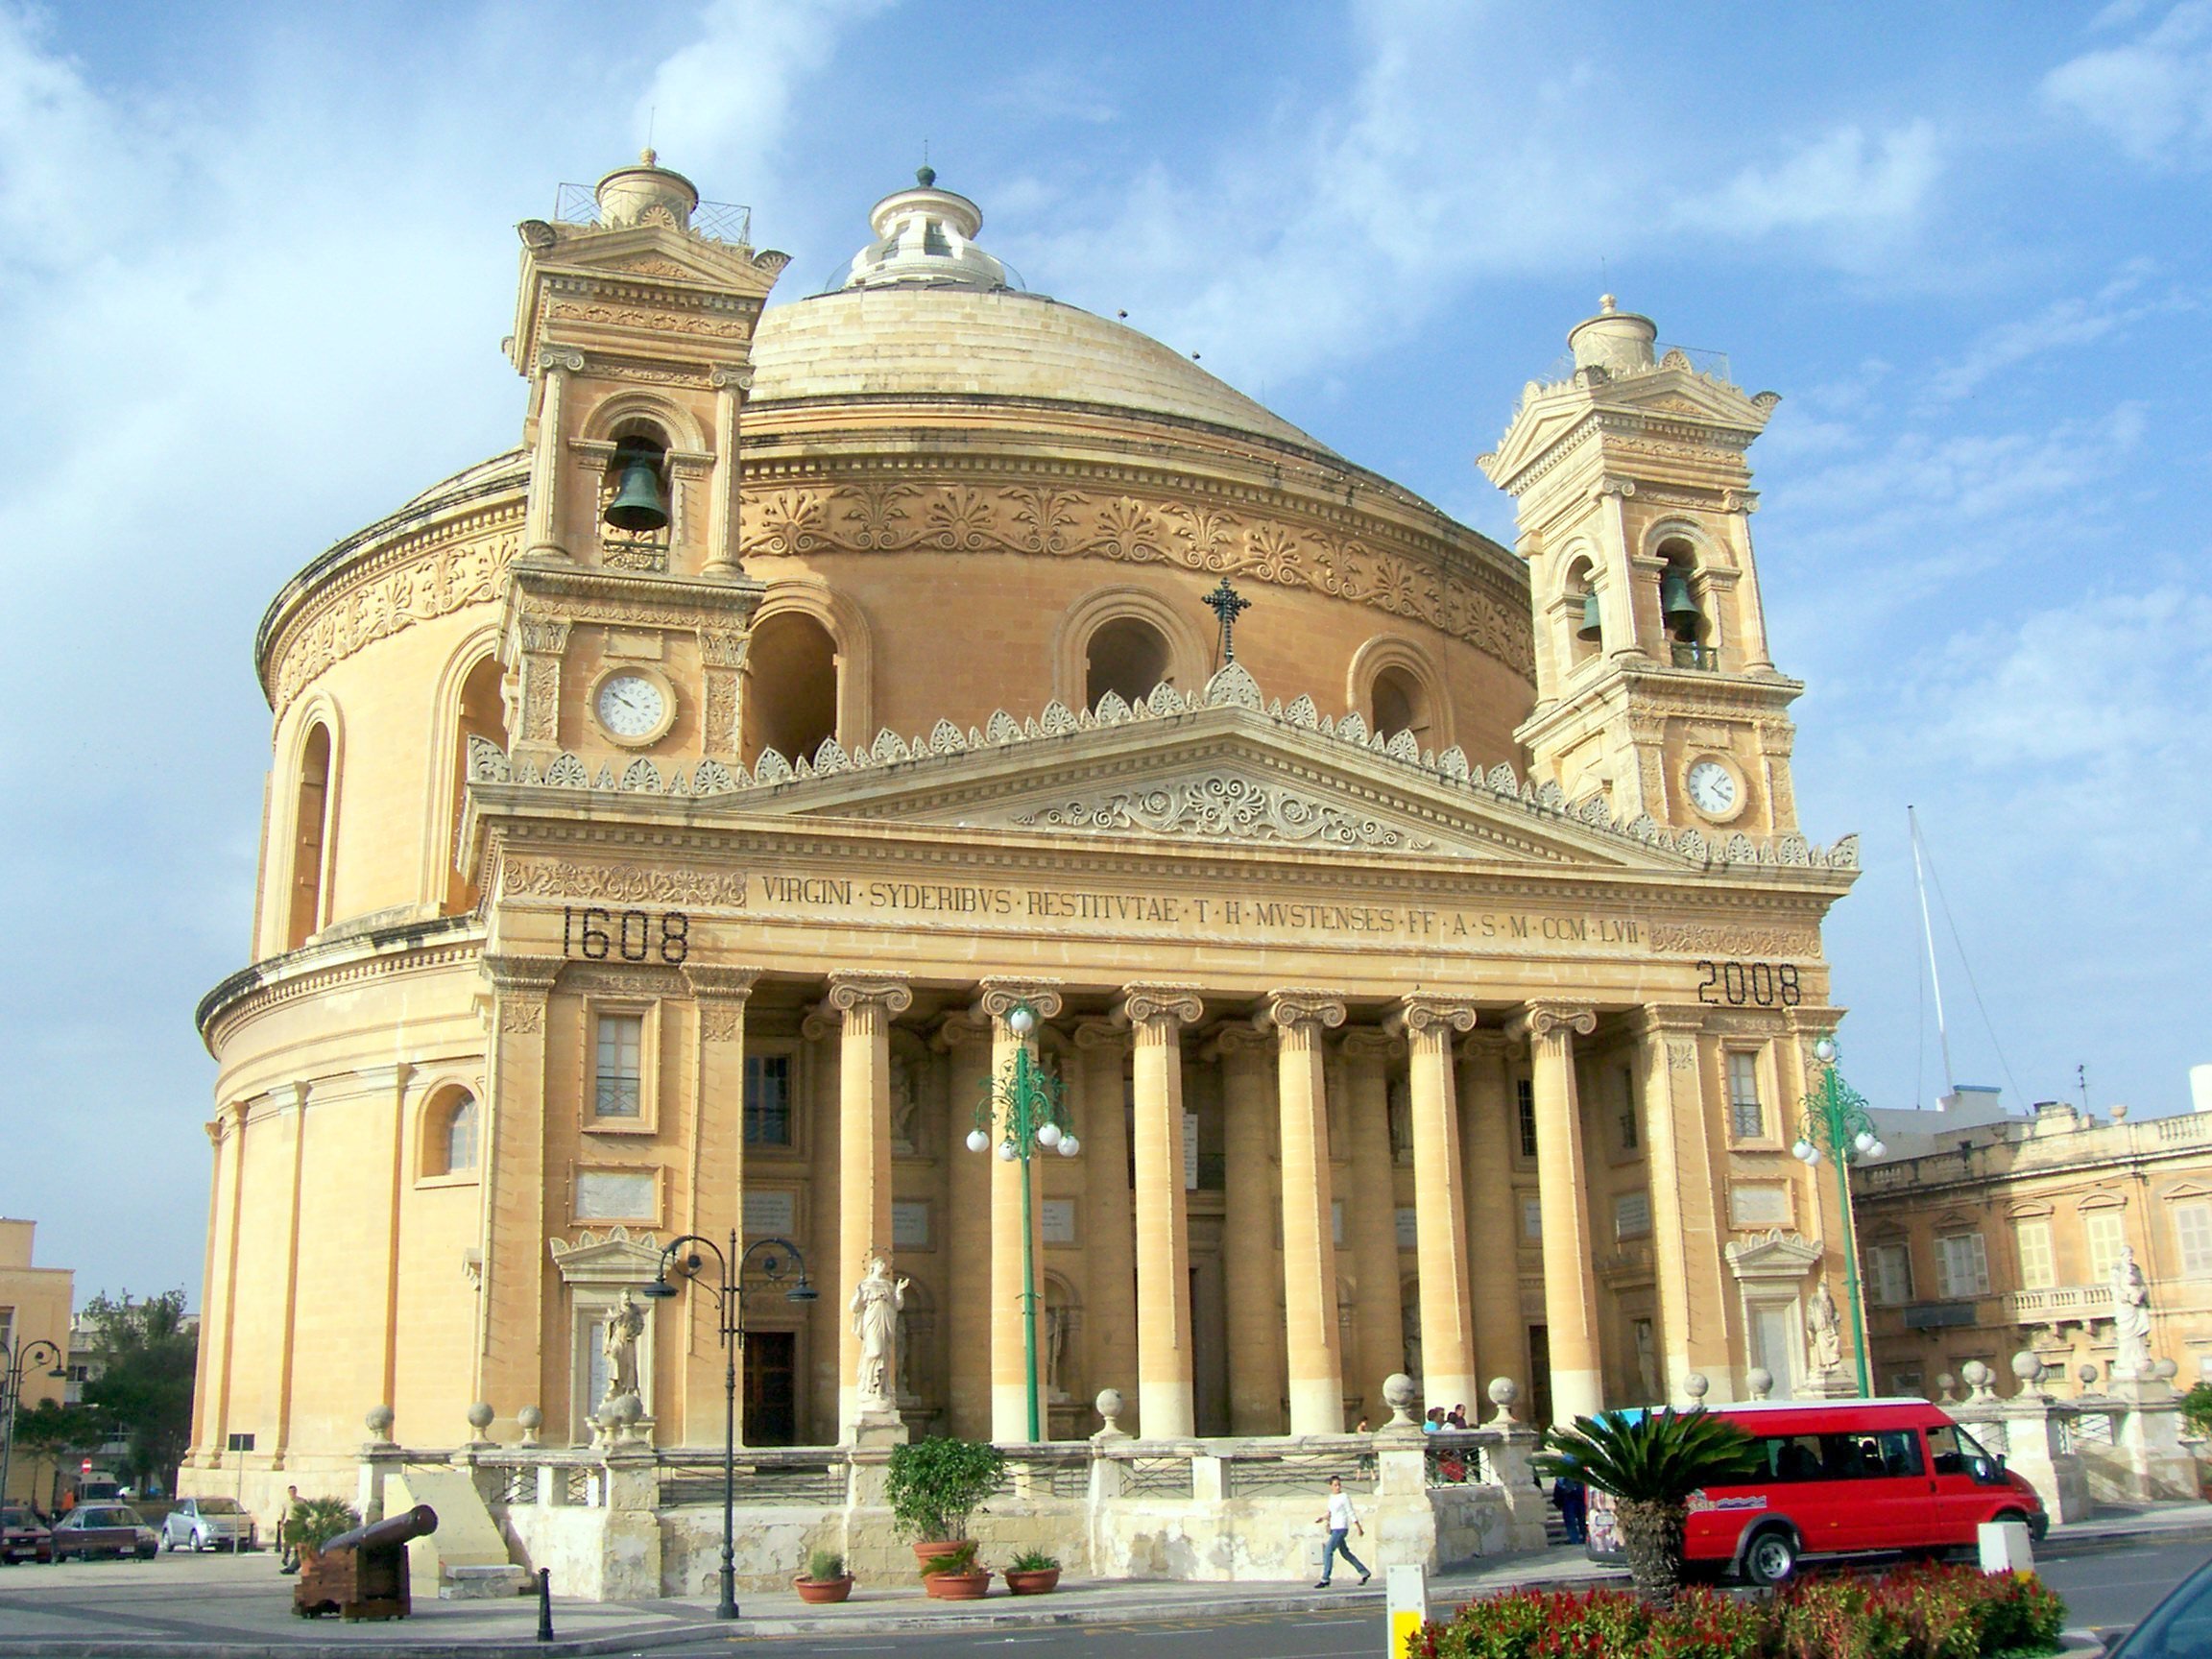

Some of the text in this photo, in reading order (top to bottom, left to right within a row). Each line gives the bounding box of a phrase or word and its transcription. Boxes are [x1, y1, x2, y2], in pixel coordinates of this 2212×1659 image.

[563, 905, 688, 964] 1608
[762, 877, 853, 905] VIRGINI
[870, 882, 1012, 914] SYDERIBVS
[1027, 891, 1178, 922] RESTITVTAE
[1194, 899, 1209, 923] T
[1225, 901, 1240, 924] H
[1256, 902, 1395, 932] MVSTENSES
[1407, 910, 1435, 933] FF
[1453, 913, 1468, 935] A
[1481, 914, 1496, 937] S
[1510, 915, 1527, 938] M
[1696, 960, 1800, 1005] 2008
